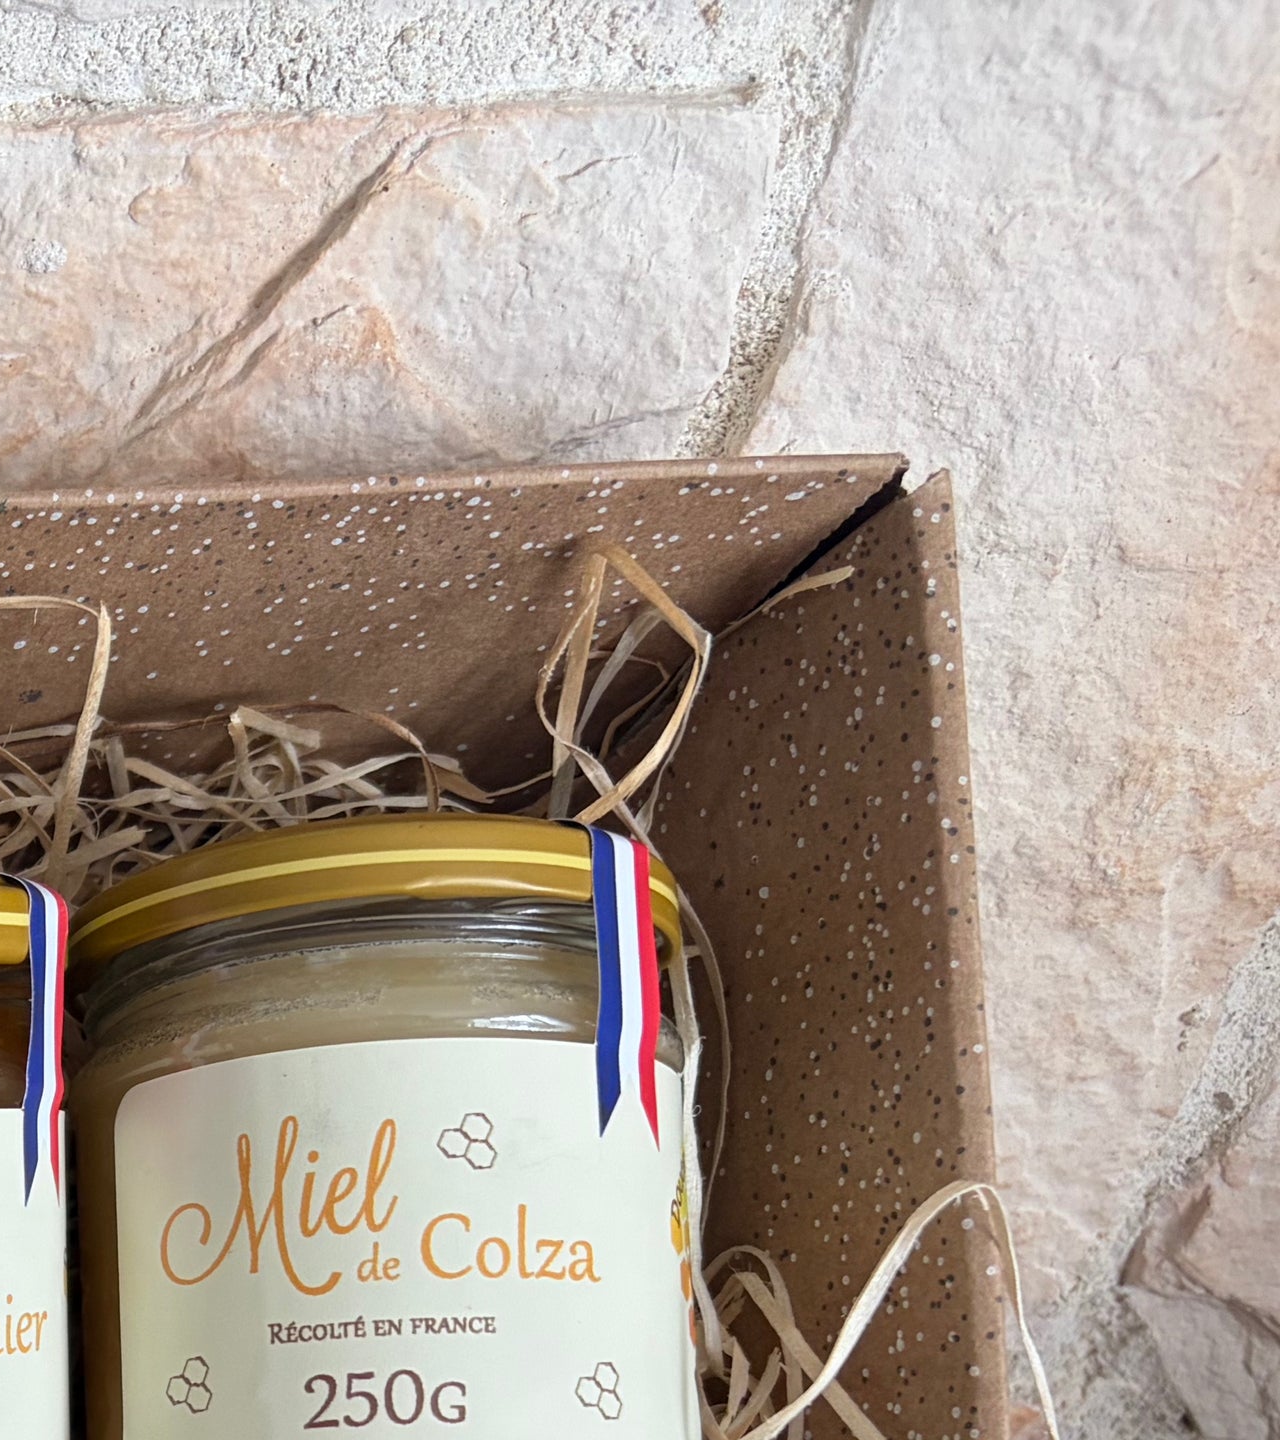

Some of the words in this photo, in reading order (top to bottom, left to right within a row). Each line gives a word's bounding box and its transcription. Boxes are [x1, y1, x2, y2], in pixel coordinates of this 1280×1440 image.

[160, 1115, 398, 1297] Miel
[357, 1242, 401, 1283] de
[420, 1204, 601, 1283] Colza
[268, 1315, 367, 1345] RÉCOLTÉ
[372, 1318, 402, 1337] EN
[410, 1315, 497, 1335] FRANCE
[303, 1368, 467, 1430] 250G
